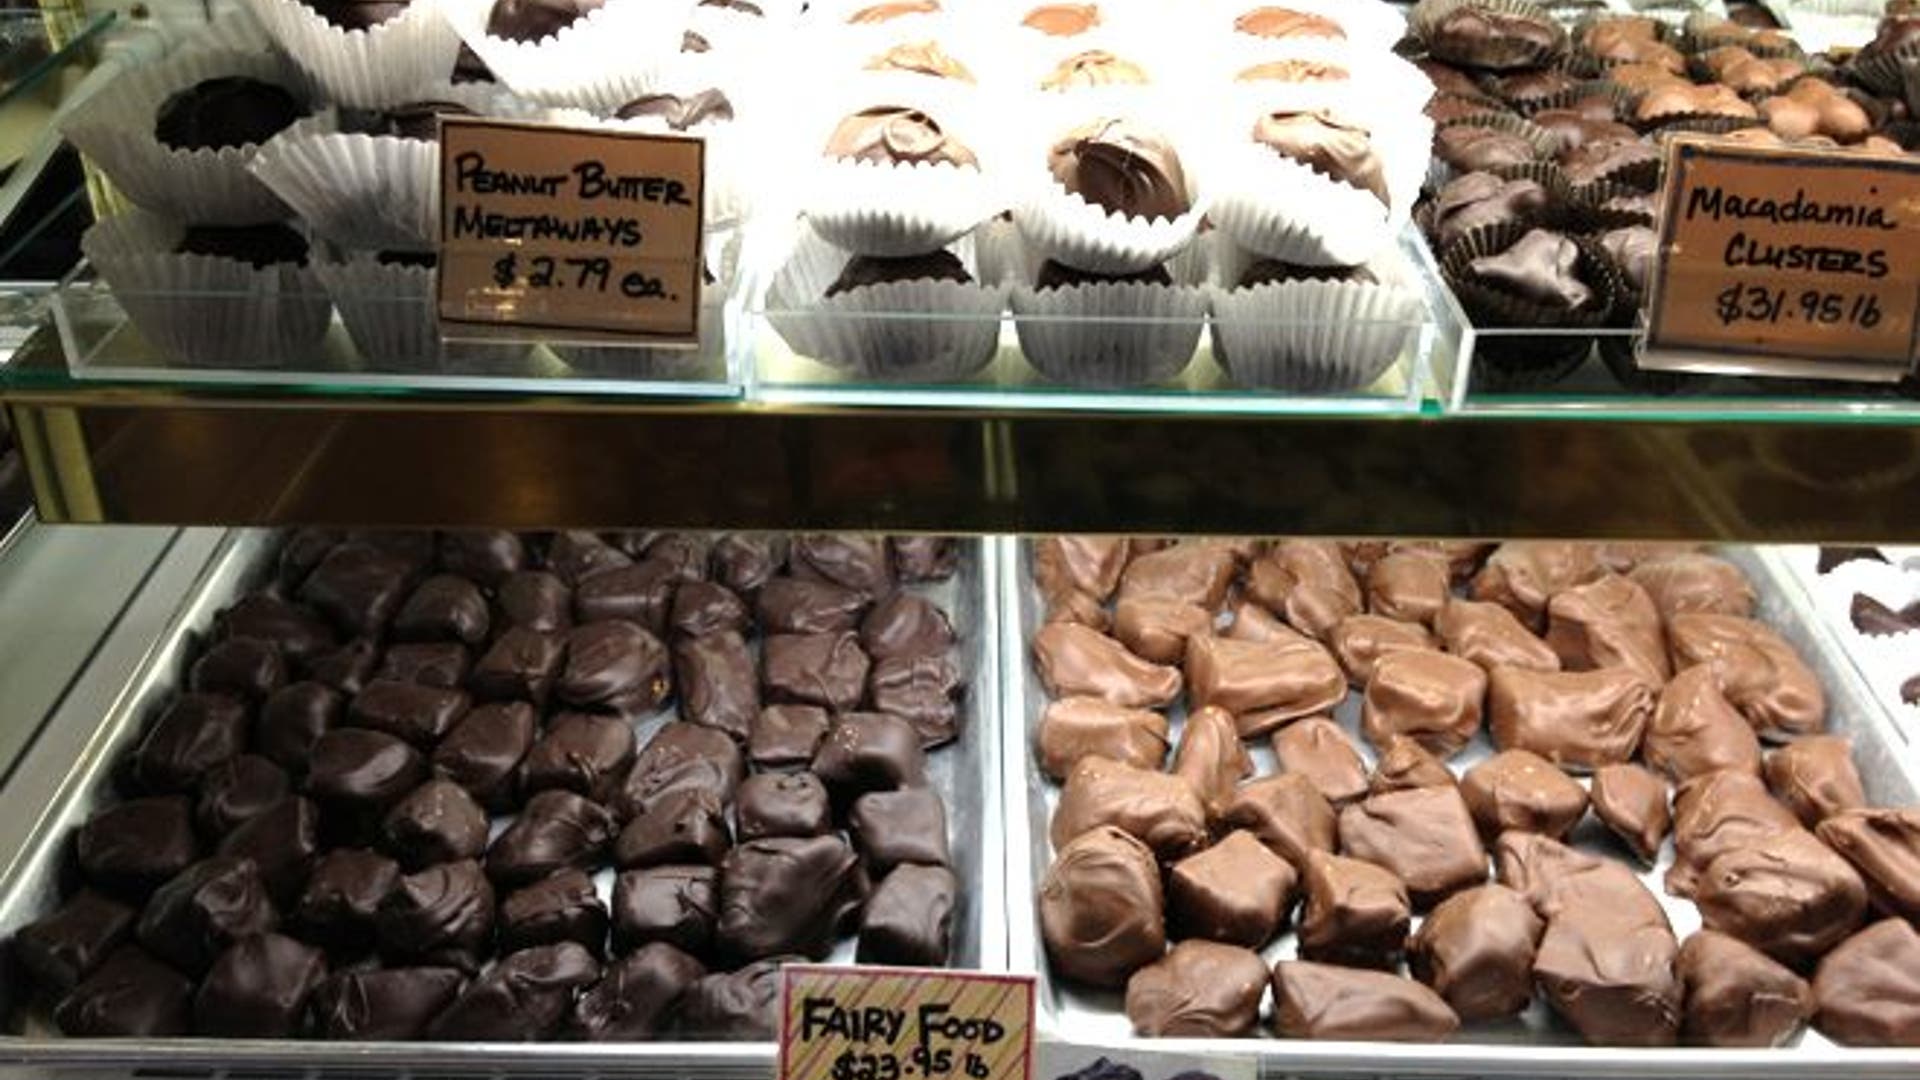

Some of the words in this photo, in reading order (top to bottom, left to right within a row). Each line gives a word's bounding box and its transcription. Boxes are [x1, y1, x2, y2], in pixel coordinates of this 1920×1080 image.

[455, 151, 568, 198] PEANUT
[573, 161, 691, 206] BUTTER
[453, 205, 642, 247] MELTAWAYS
[1687, 187, 1898, 230] Macadamia
[1724, 233, 1889, 278] CLUSTERS
[1717, 283, 1843, 325] $31.95
[801, 997, 905, 1045] FAIRY
[919, 1003, 1005, 1050] FOOD
